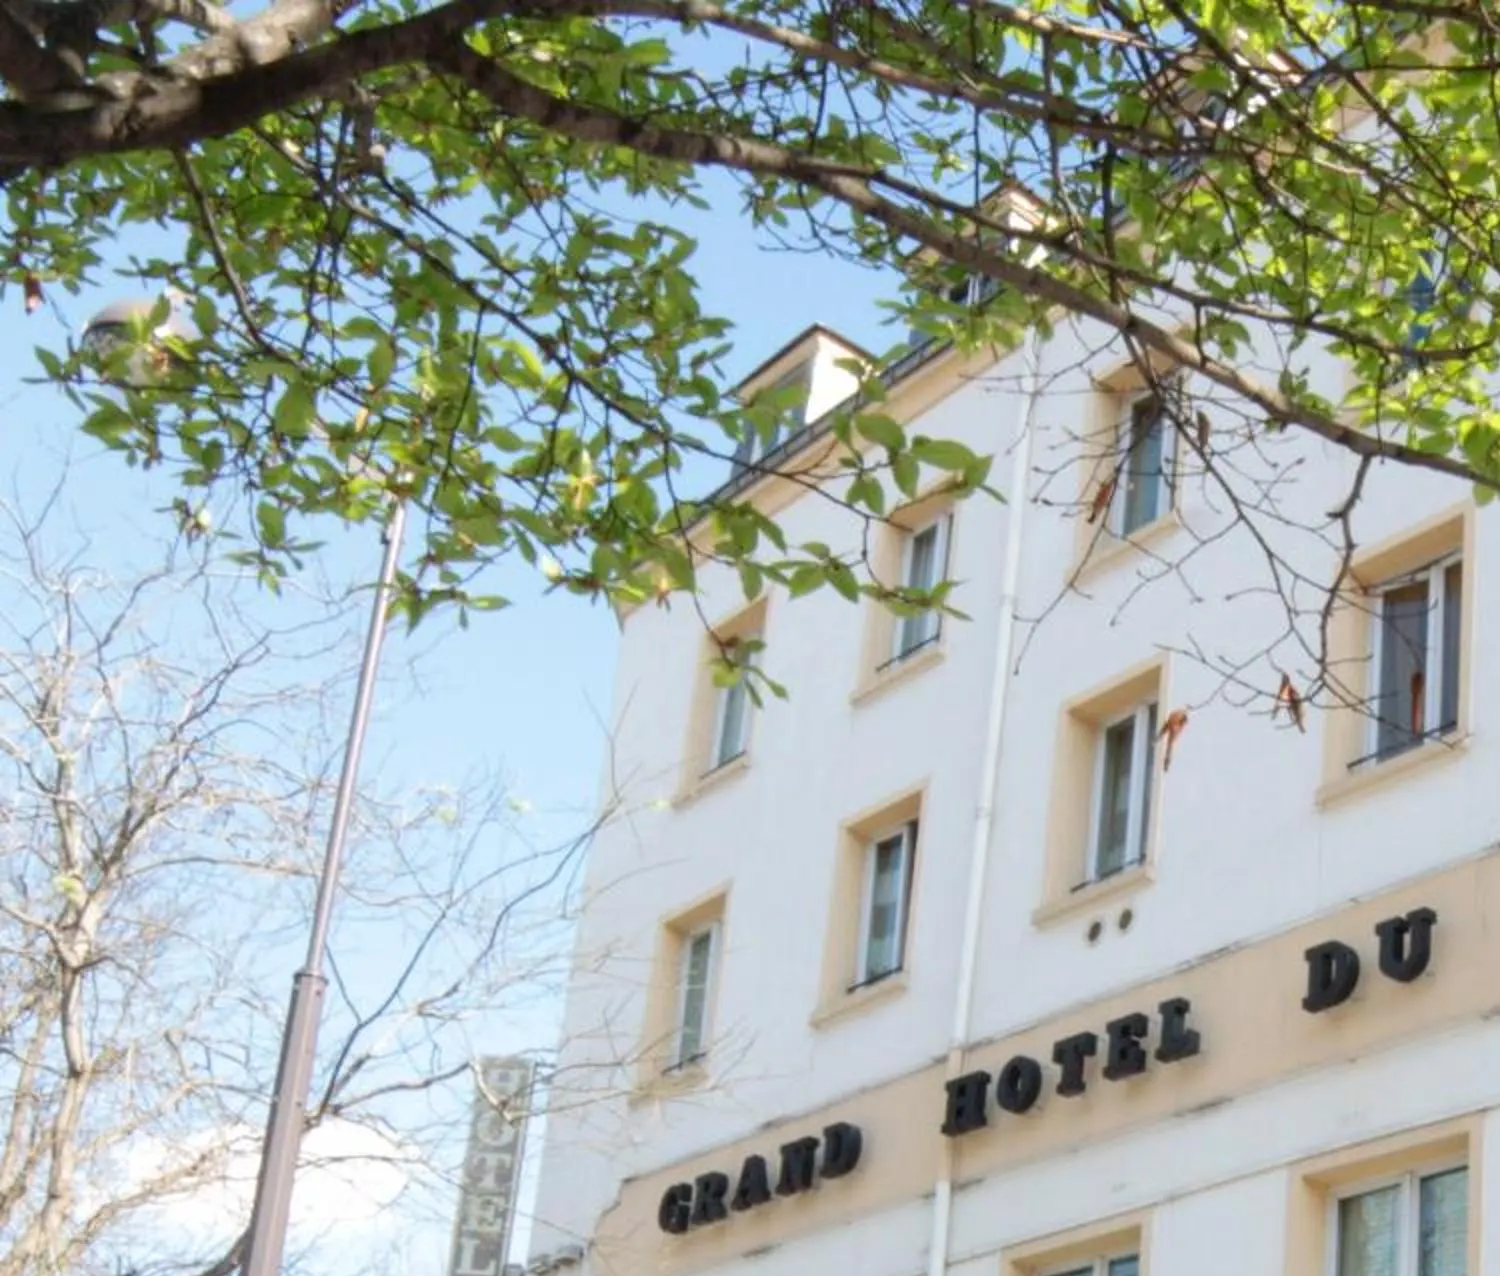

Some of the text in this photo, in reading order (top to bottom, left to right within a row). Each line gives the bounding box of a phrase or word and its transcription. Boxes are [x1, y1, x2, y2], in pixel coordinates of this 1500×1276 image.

[658, 1121, 863, 1234] GRAND
[941, 997, 1200, 1137] HOTEL
[1302, 906, 1437, 1013] DU
